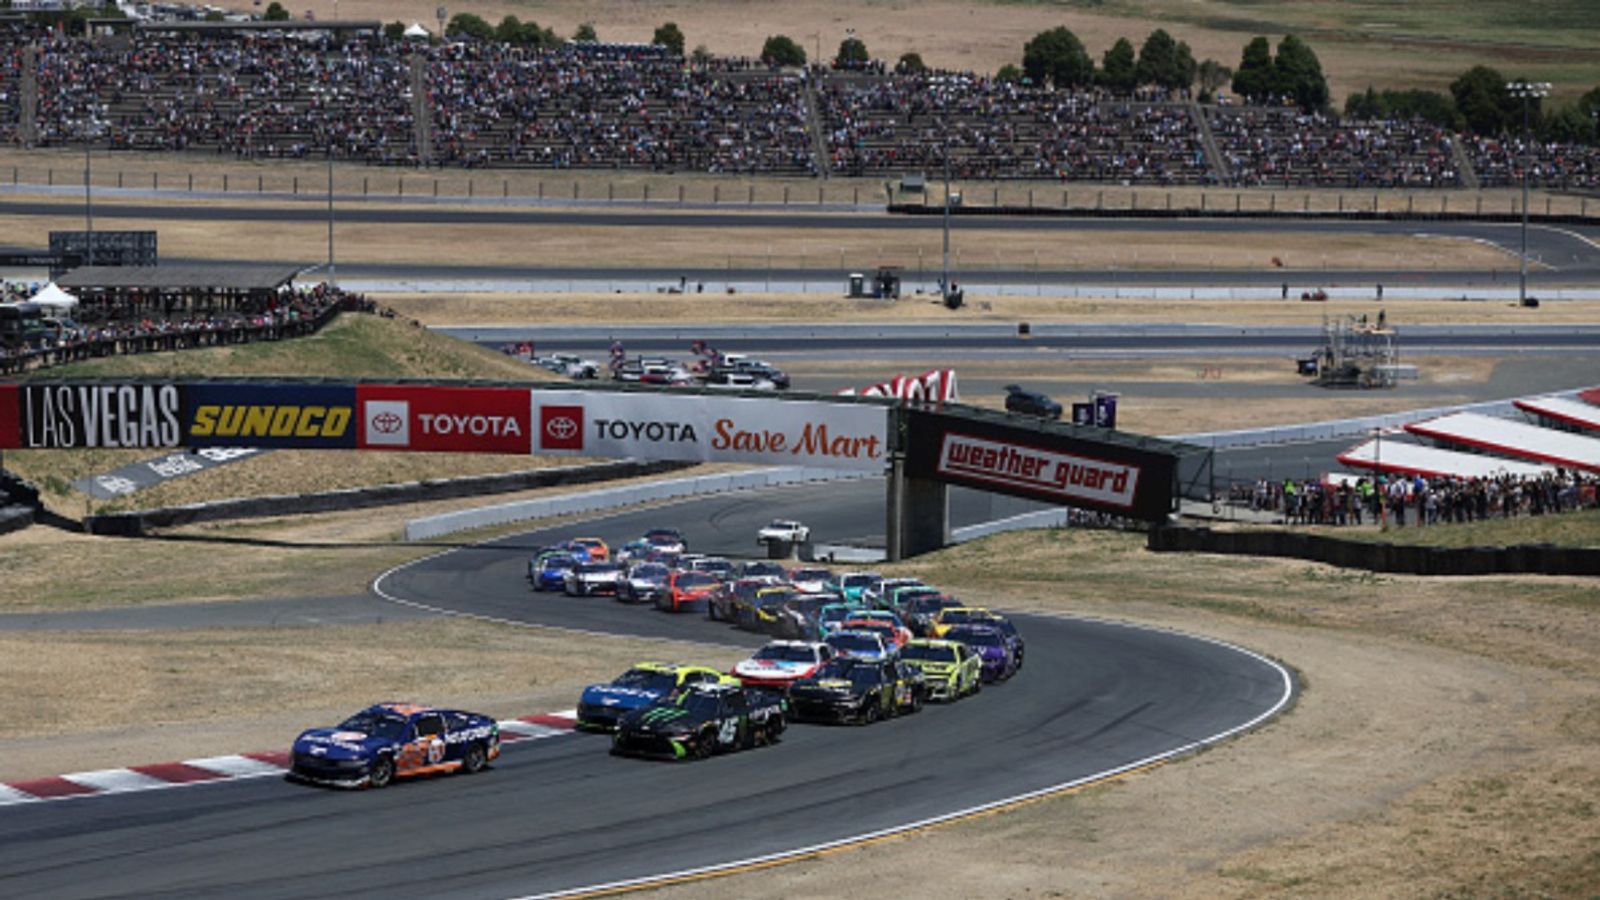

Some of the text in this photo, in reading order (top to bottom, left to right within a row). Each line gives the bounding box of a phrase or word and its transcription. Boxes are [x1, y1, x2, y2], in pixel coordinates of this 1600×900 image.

[26, 386, 180, 447] LAS VEGAS
[191, 405, 352, 437] SUNOCO
[418, 413, 521, 436] TOYOTA
[594, 419, 697, 442] TOYOTA
[711, 418, 882, 458] Save Mart
[948, 441, 1130, 493] weather guard
